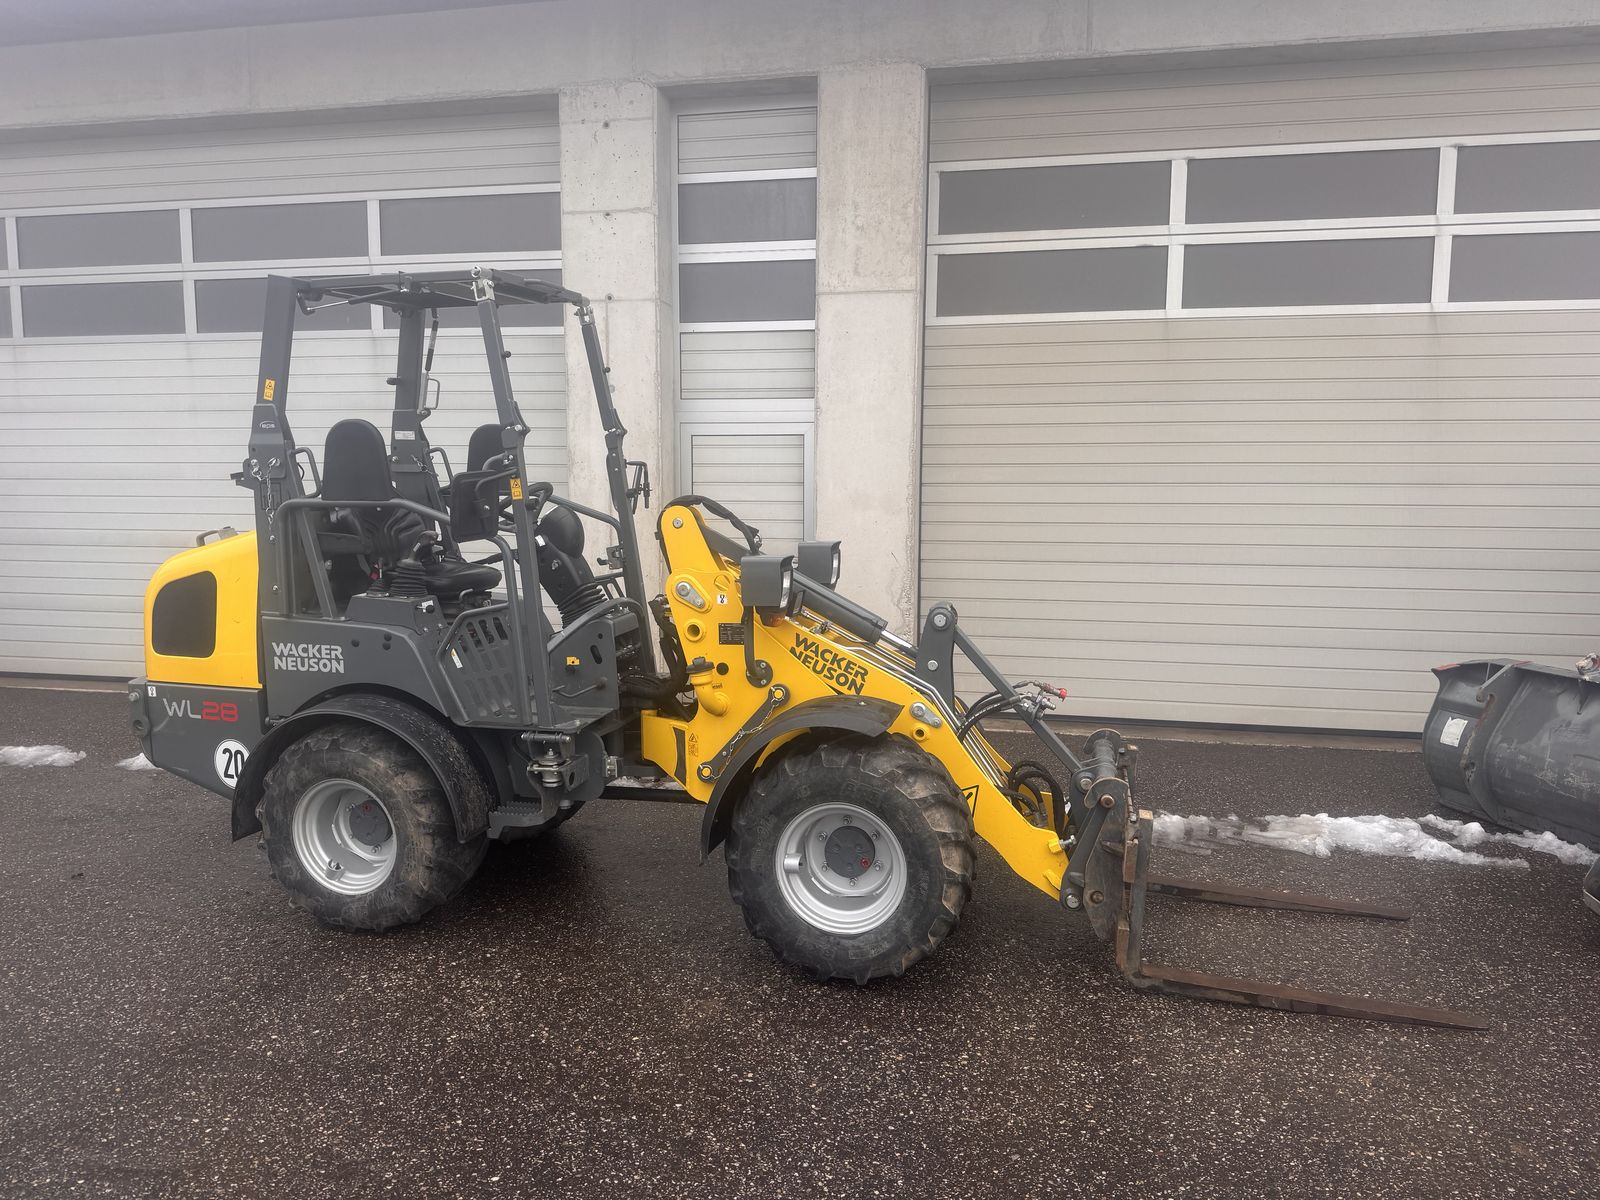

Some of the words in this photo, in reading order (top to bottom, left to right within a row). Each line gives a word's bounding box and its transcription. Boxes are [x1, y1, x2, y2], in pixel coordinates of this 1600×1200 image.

[271, 642, 344, 660] WACKER
[273, 656, 345, 674] NEUSON
[796, 632, 869, 683] WACKER
[789, 646, 865, 696] NEUSON
[162, 698, 239, 722] WL28
[222, 747, 246, 780] 20
